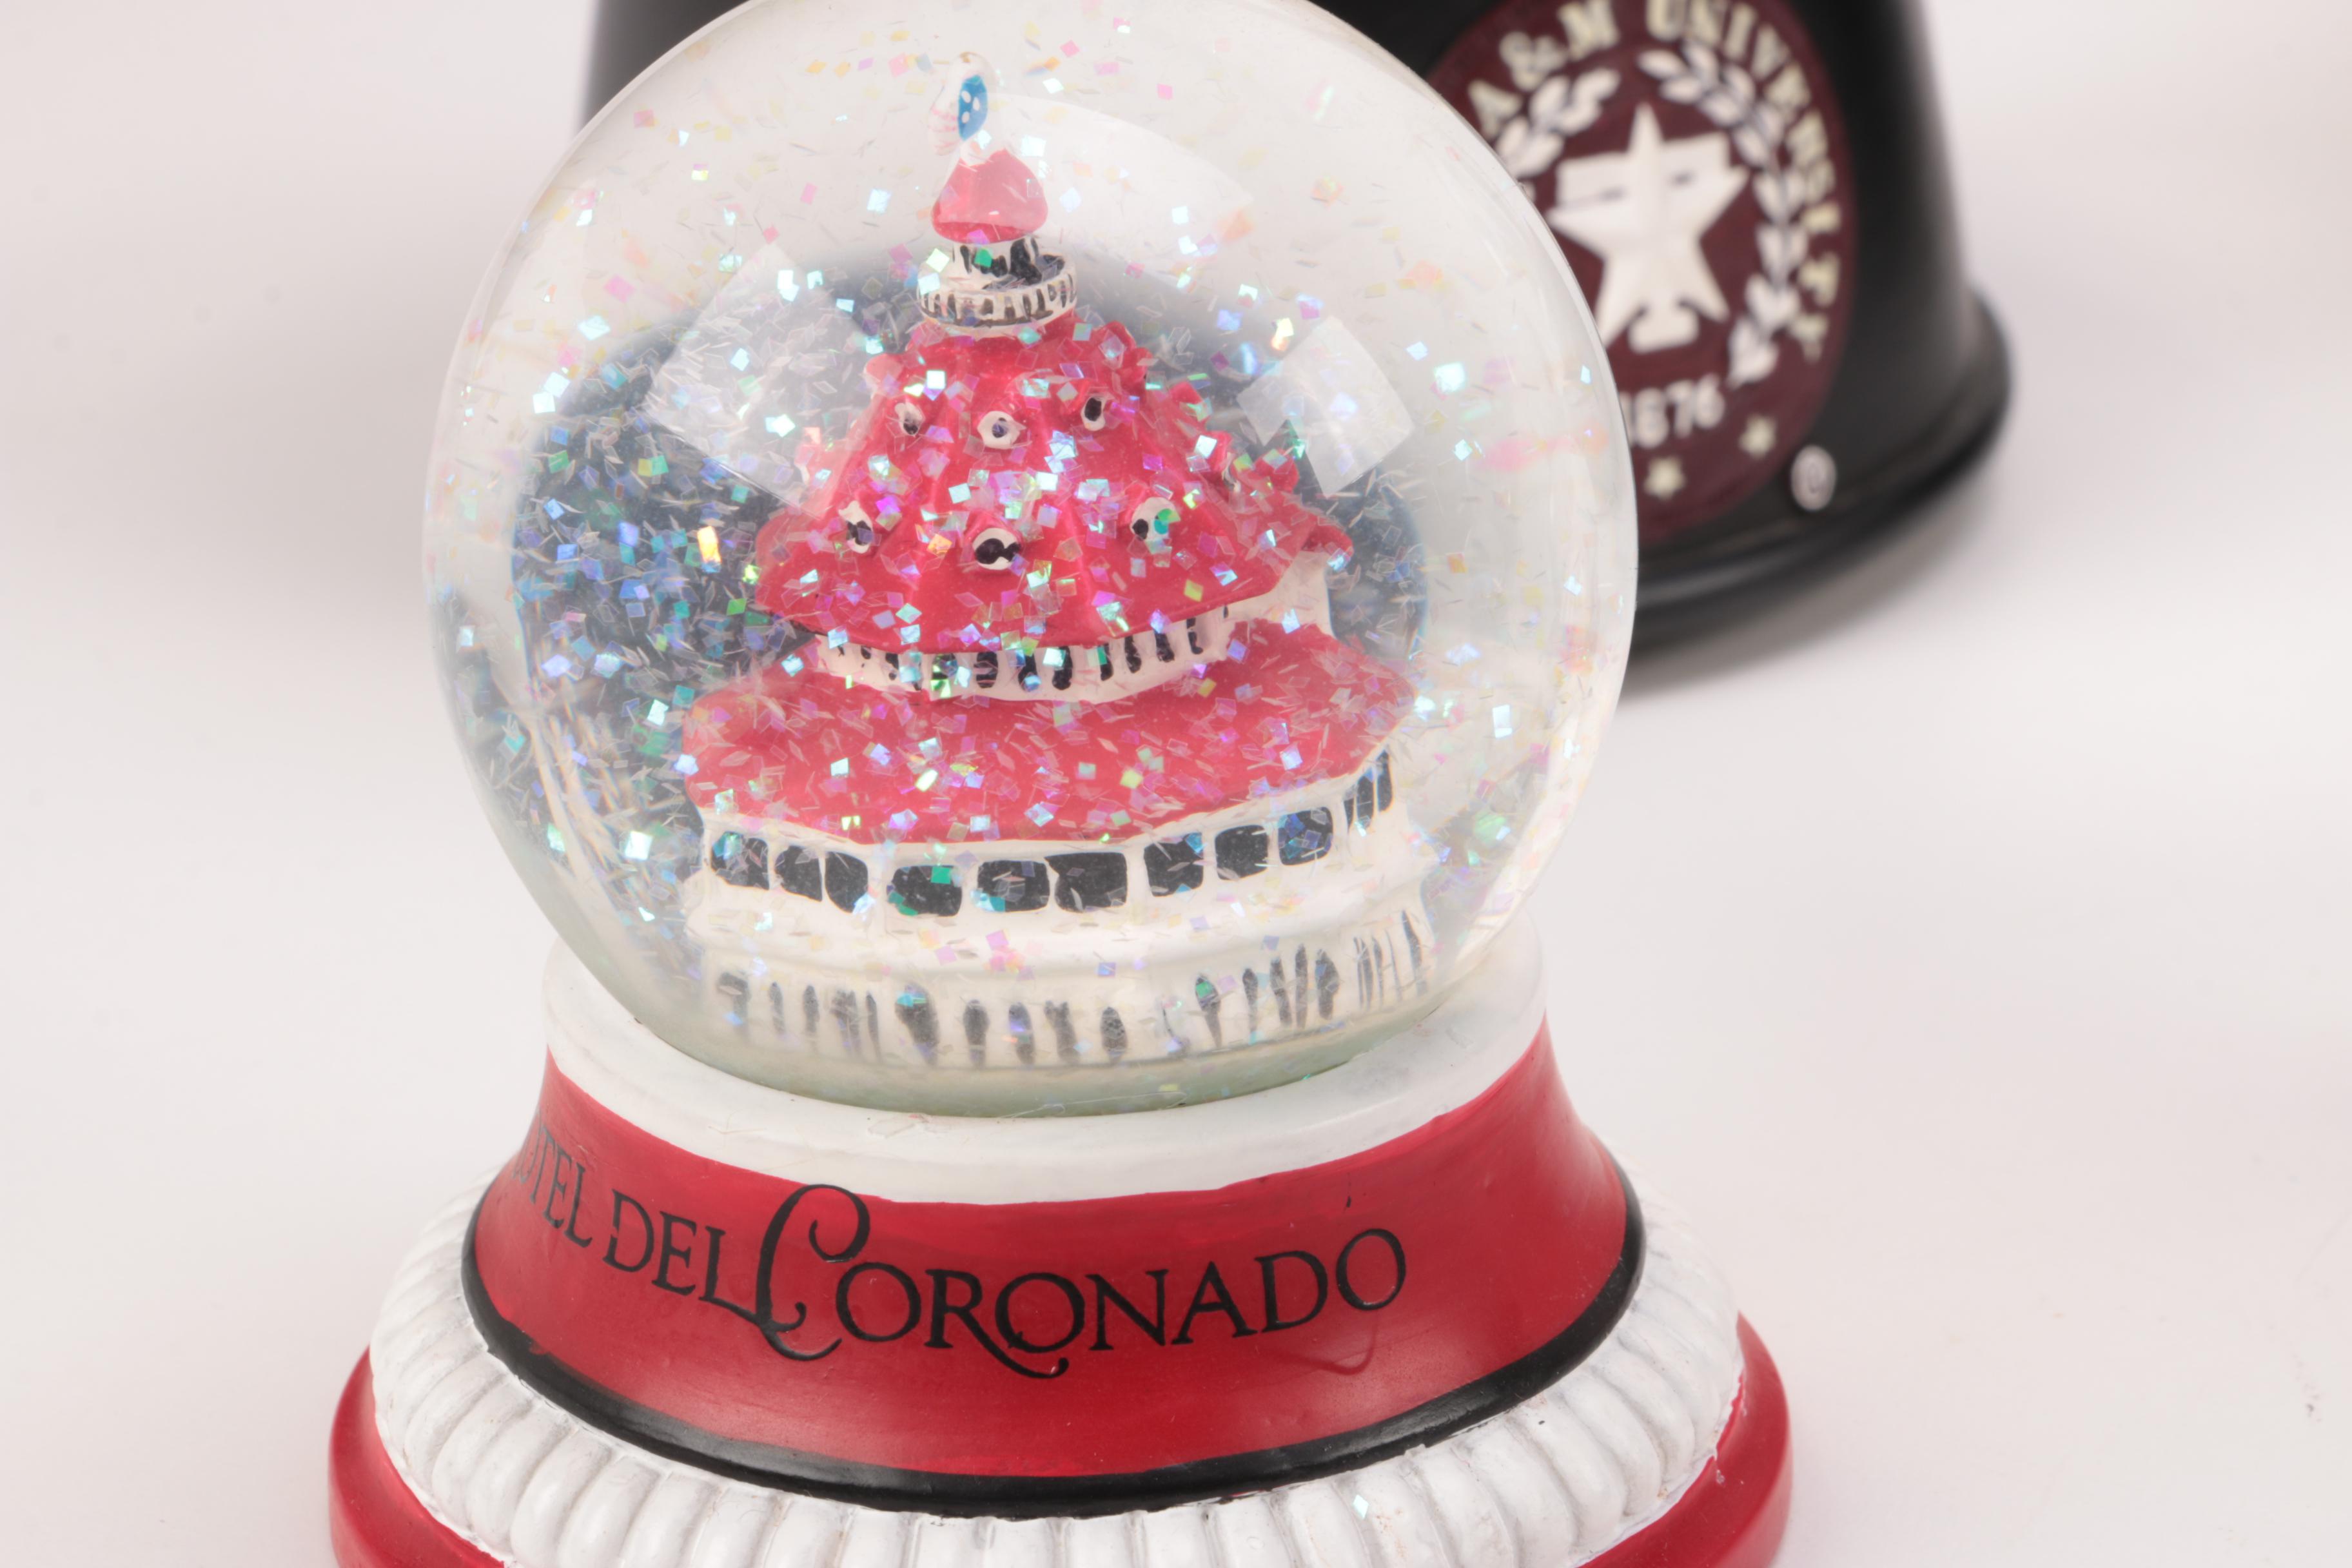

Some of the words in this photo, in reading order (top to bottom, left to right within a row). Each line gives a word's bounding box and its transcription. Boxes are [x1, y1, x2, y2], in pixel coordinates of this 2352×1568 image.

[513, 1113, 593, 1248] OTEL
[602, 1188, 761, 1326] DEL
[756, 1184, 1407, 1378] CORONADO
